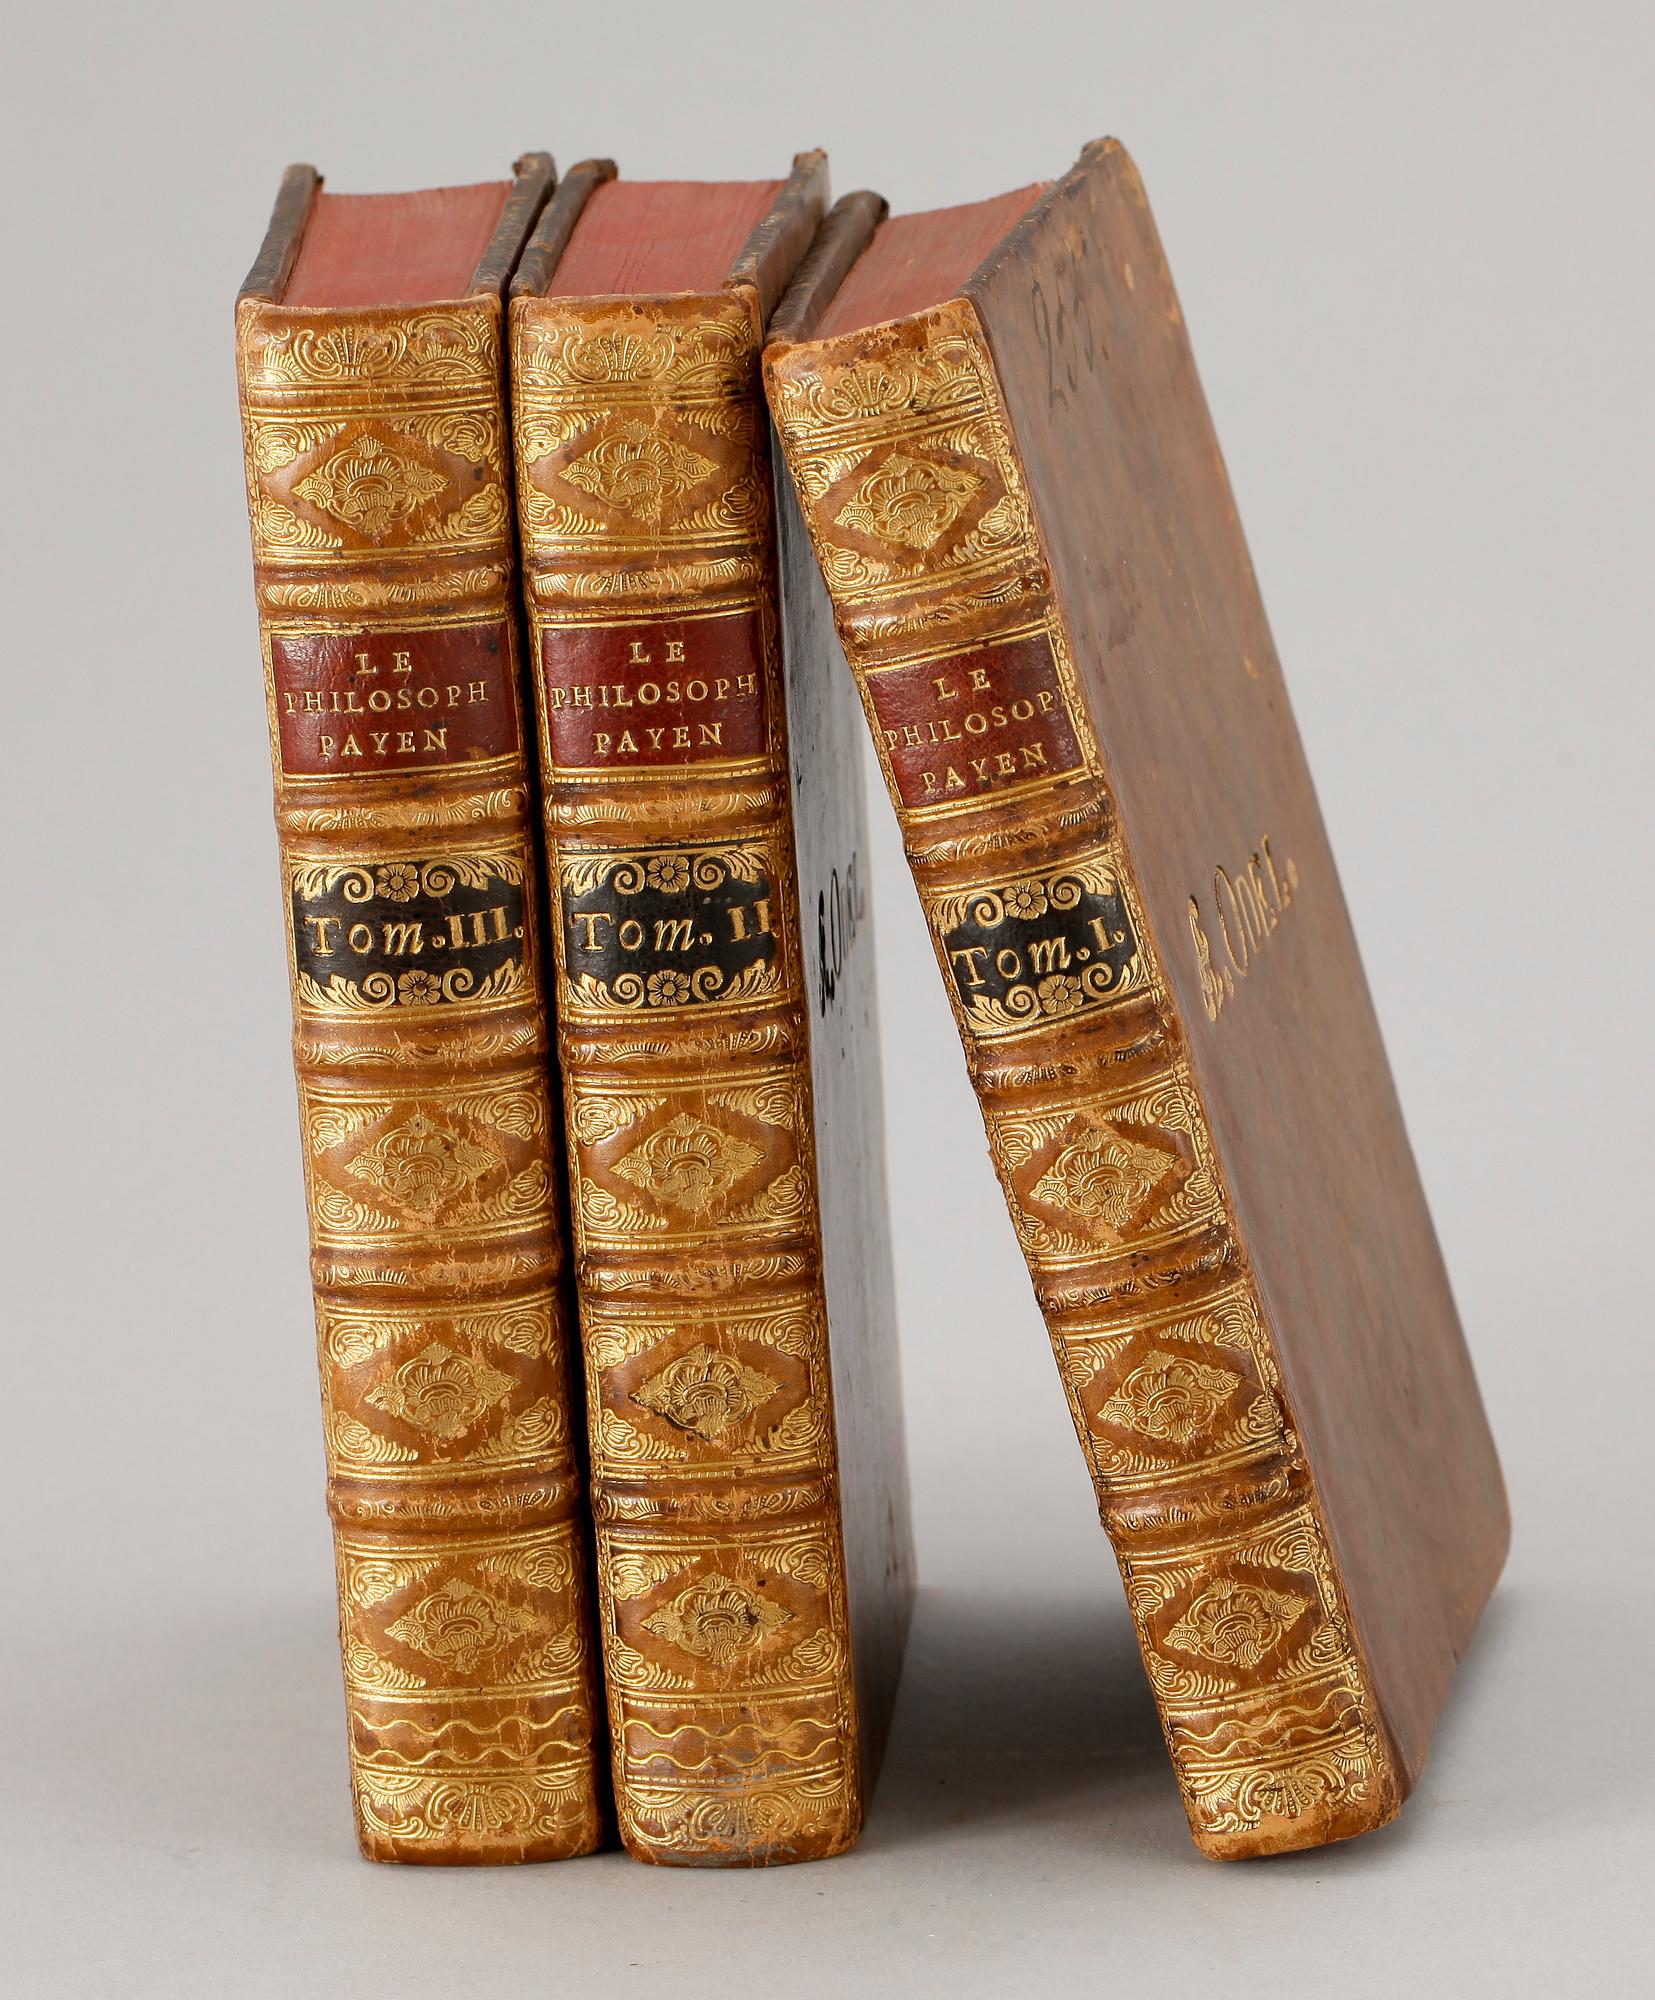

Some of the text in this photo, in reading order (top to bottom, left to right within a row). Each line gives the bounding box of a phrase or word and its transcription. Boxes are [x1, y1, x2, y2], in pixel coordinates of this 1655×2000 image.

[355, 651, 413, 676] LE
[629, 641, 686, 665] LE
[284, 681, 489, 714] PHILOSOPH
[552, 672, 759, 710] PHILOSOPH
[933, 668, 992, 701] LE
[319, 728, 449, 758] PAYEN
[593, 722, 723, 755] PAYEN
[920, 742, 1048, 795] PAYEN
[570, 912, 713, 952] Tom.
